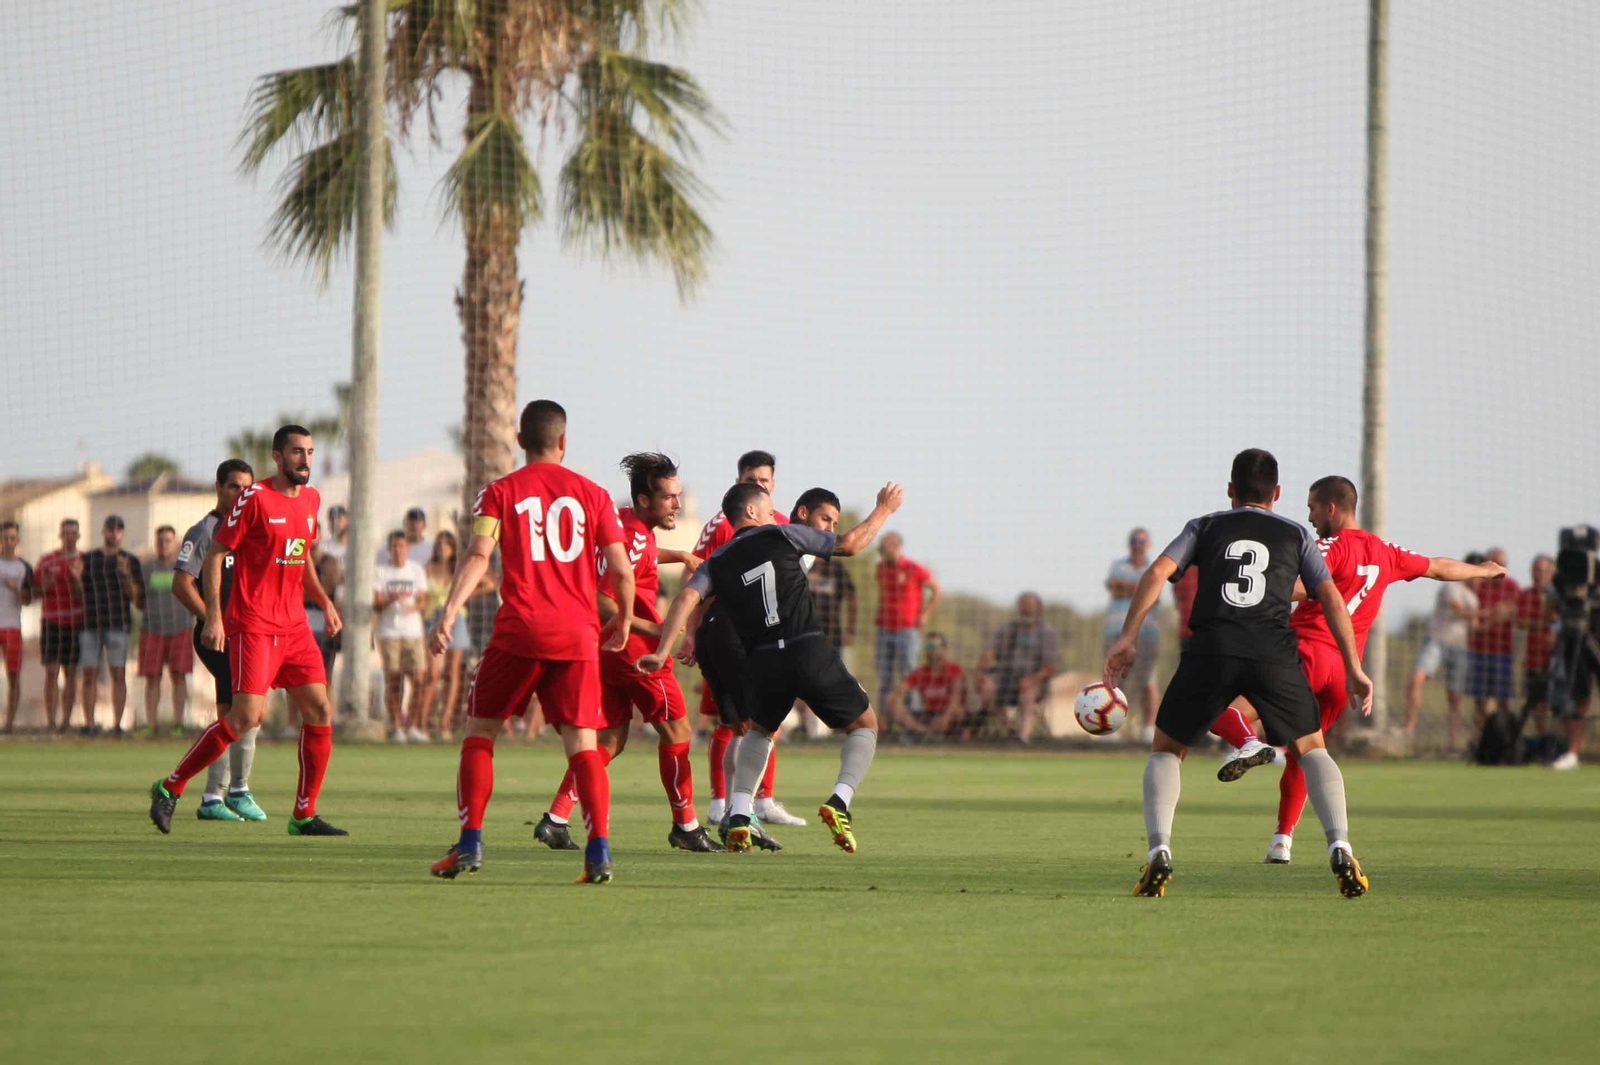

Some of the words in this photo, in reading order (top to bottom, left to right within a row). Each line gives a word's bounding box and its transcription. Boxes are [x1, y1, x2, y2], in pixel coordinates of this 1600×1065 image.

[285, 538, 307, 557] VS
[514, 495, 586, 563] 10
[741, 560, 781, 628] 7
[1221, 539, 1270, 608] 3
[1346, 564, 1380, 616] 7
